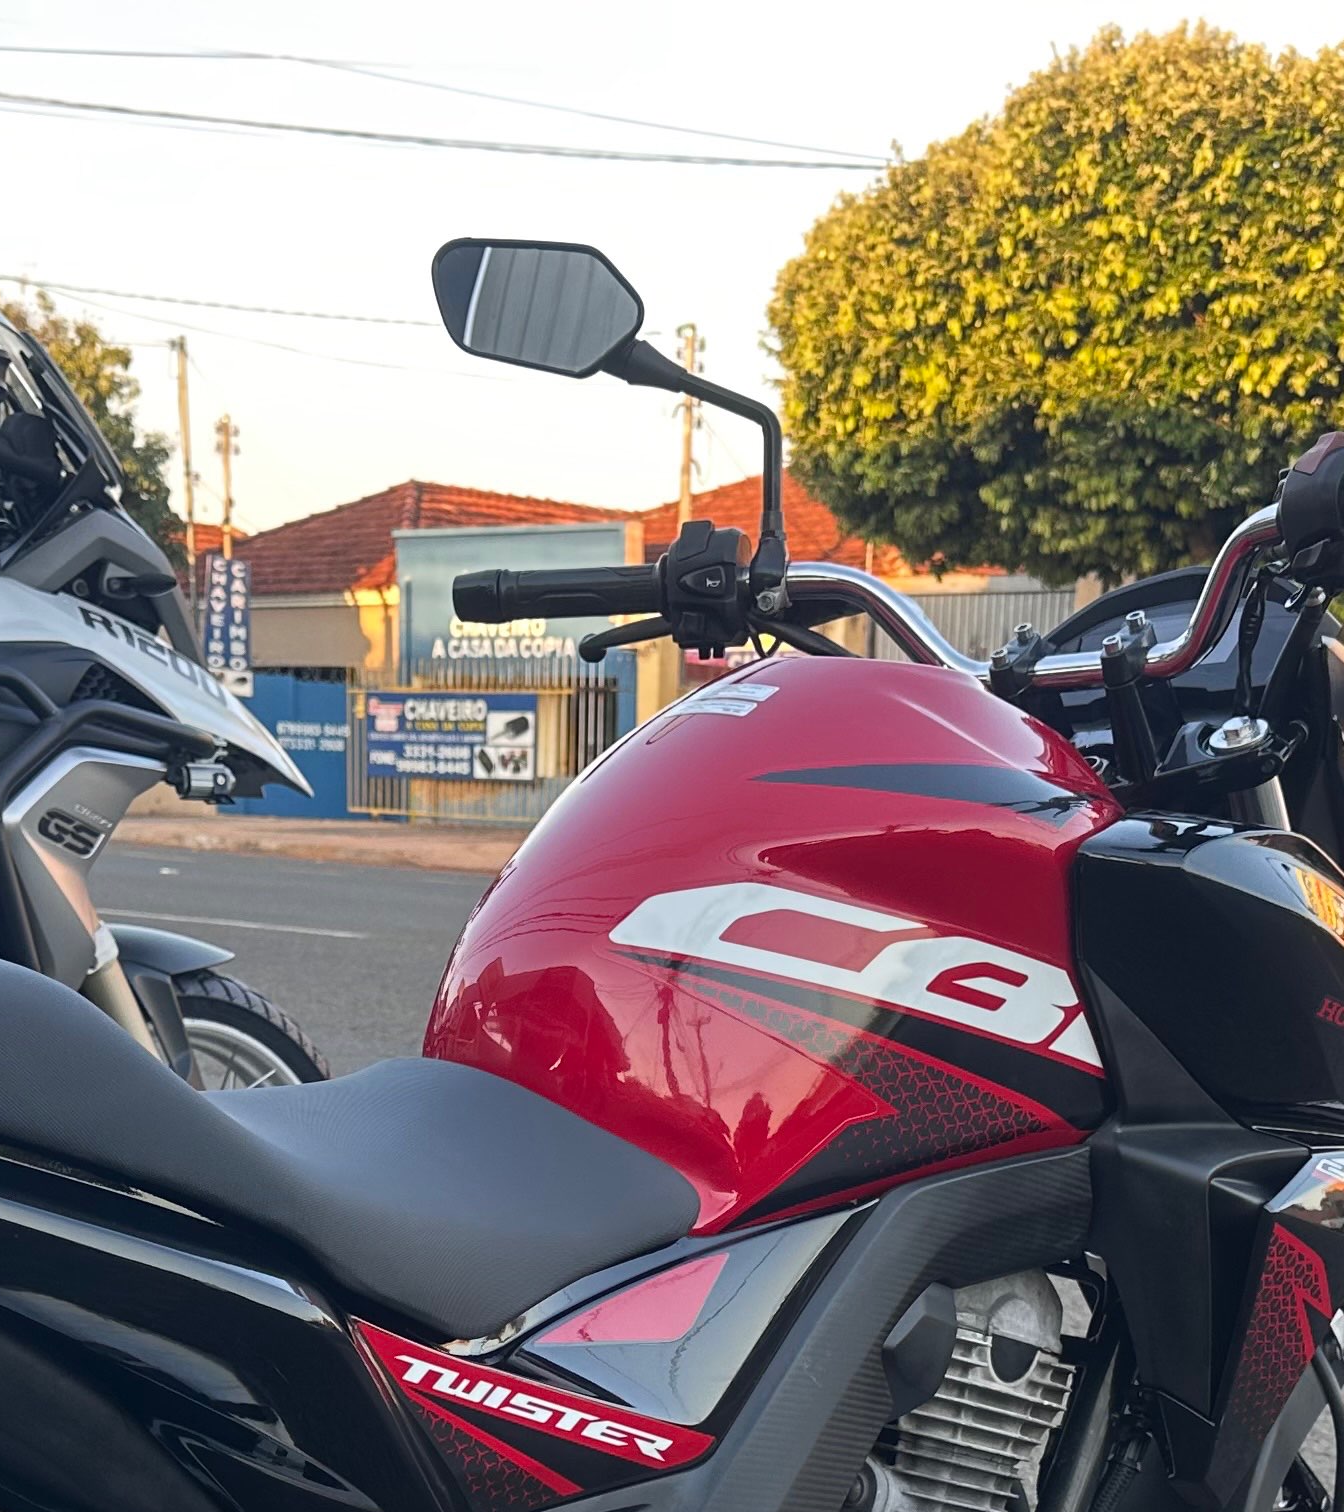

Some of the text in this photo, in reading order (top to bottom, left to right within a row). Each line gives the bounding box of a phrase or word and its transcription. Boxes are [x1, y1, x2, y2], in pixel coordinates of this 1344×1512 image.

[207, 558, 227, 668] CHAVEIRO
[229, 560, 247, 671] CARIMBO
[431, 637, 447, 659] A
[448, 637, 493, 659] CASA
[494, 638, 518, 659] DA
[404, 698, 488, 721] CHAVEIRO
[38, 808, 105, 857] GS
[394, 1355, 674, 1461] TWISTER
